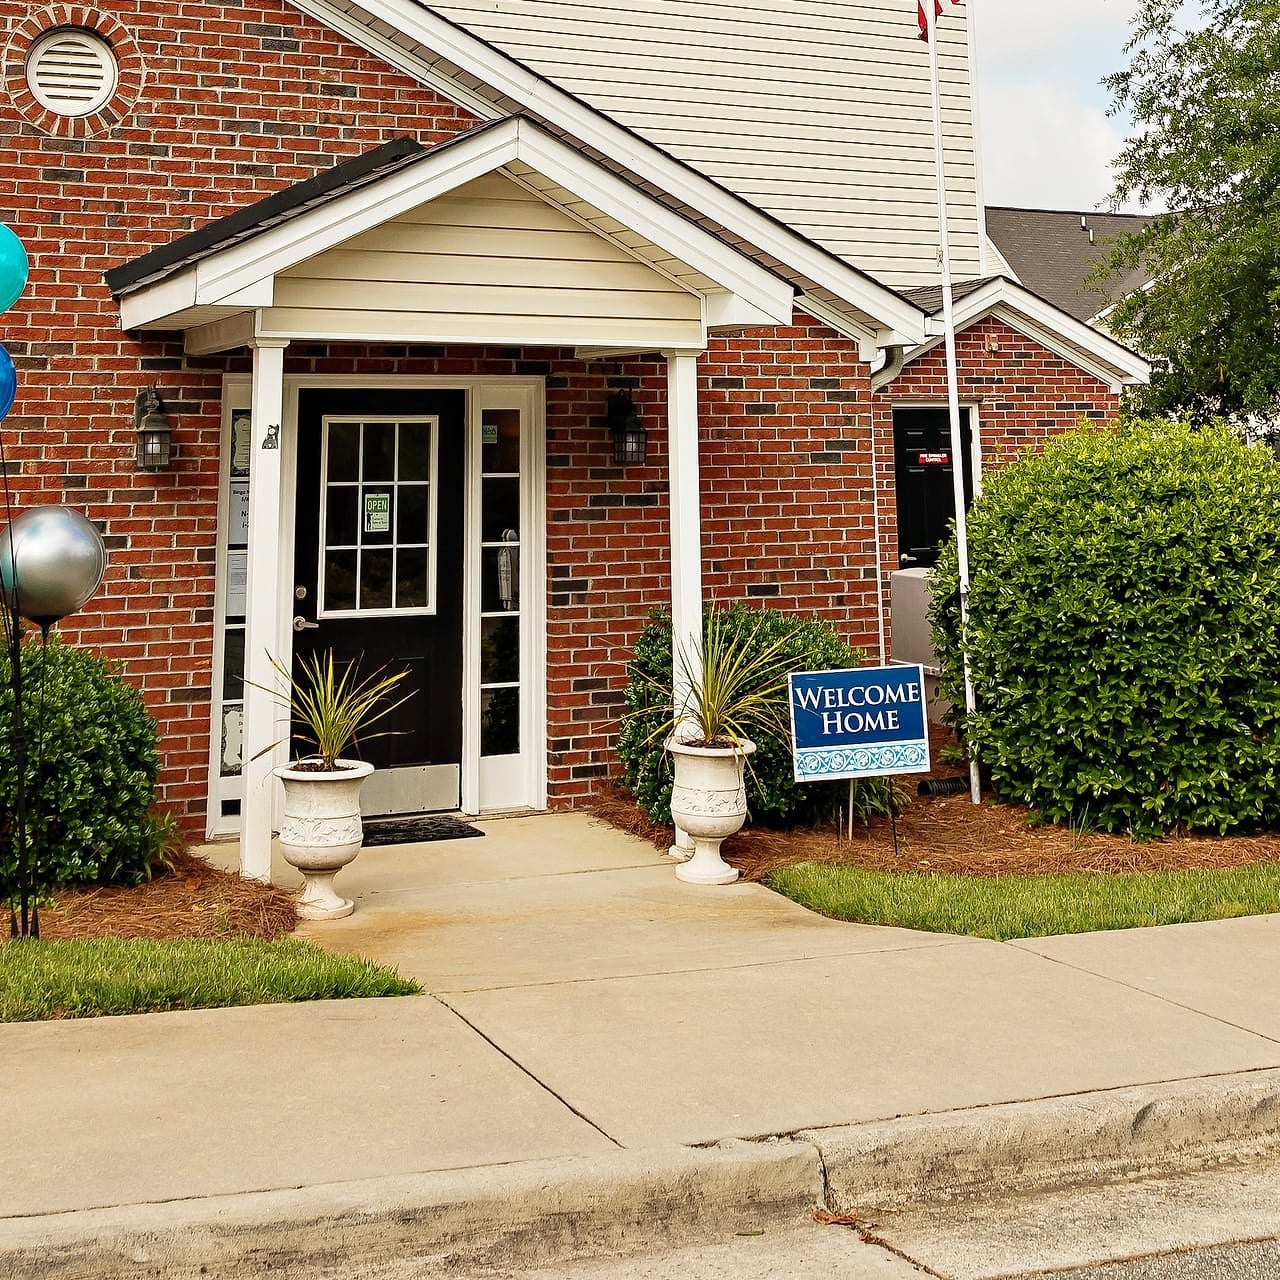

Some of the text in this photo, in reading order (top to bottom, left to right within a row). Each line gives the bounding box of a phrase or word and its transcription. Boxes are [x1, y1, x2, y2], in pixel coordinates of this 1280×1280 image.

[367, 500, 387, 510] OPEN
[794, 682, 920, 710] WELCOME
[821, 710, 900, 735] HOME
